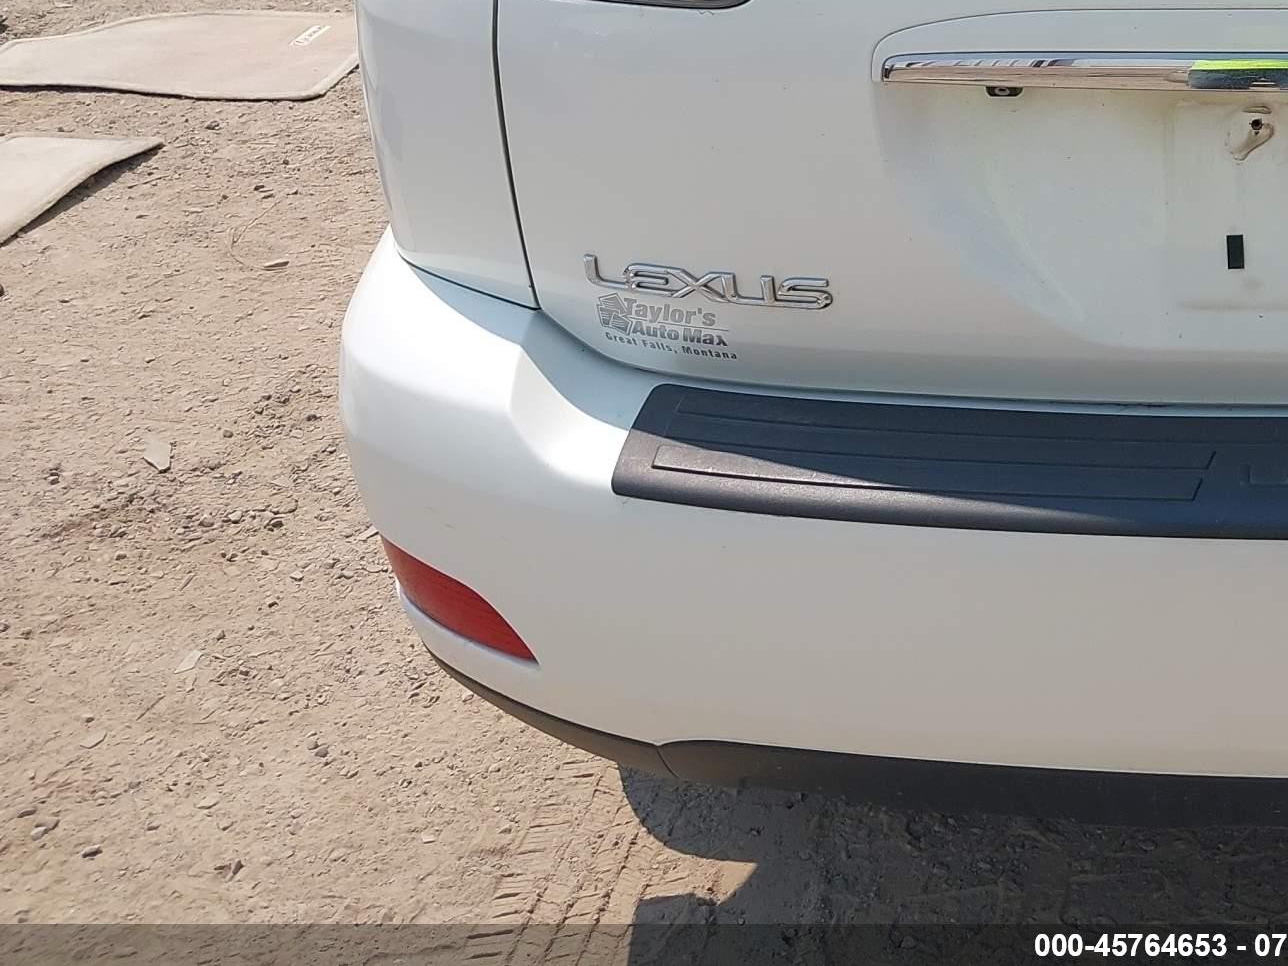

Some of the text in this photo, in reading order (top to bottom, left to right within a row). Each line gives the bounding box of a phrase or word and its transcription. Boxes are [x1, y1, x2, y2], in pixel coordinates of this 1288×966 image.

[583, 253, 833, 310] LEXUS
[624, 297, 717, 327] Taylor's
[605, 331, 738, 360] Great Falls, Montana
[631, 320, 734, 346] Auto Max
